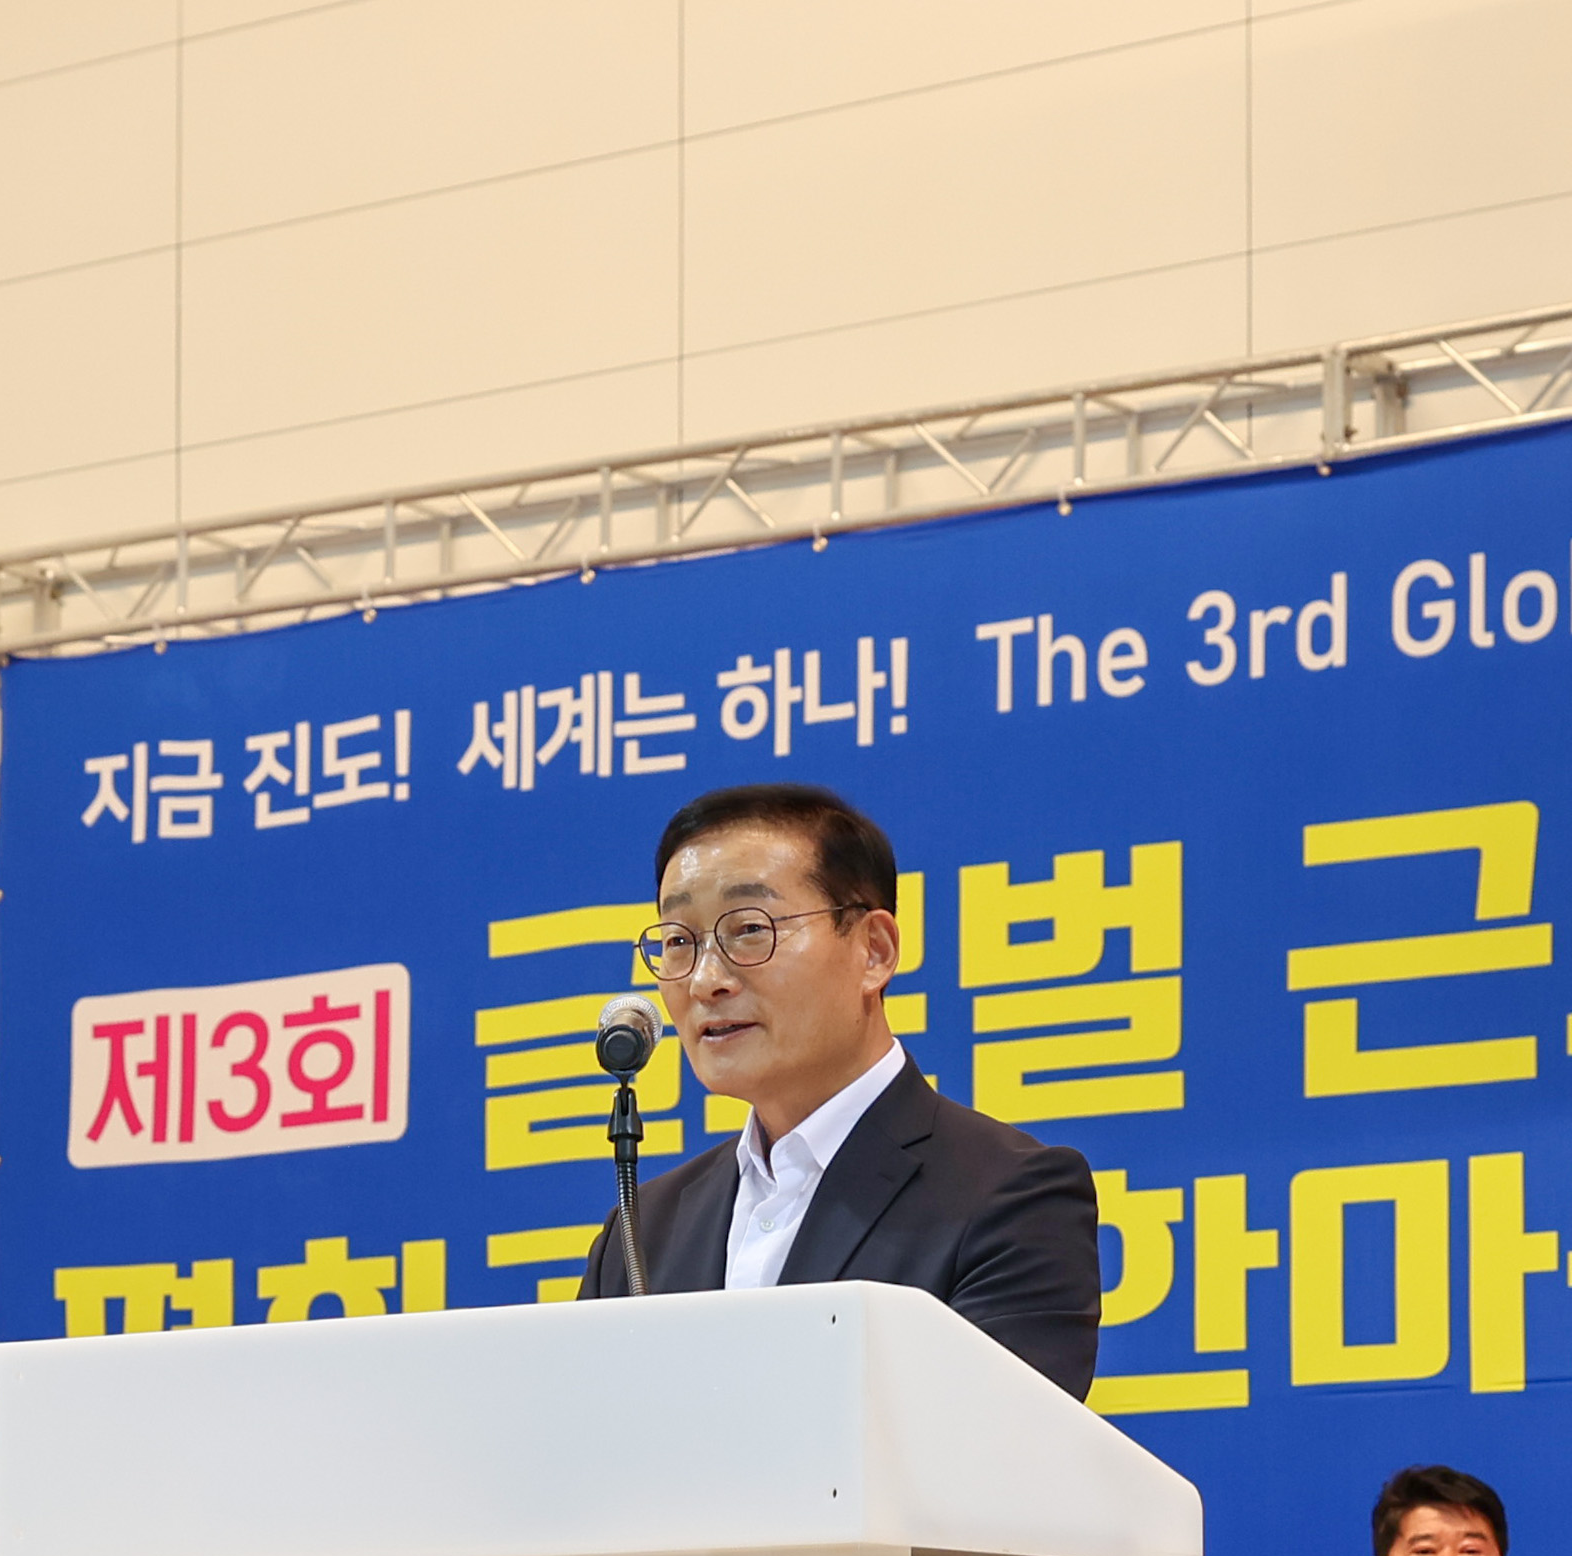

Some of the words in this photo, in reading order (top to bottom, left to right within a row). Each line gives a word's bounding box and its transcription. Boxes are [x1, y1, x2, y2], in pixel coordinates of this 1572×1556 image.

[81, 742, 223, 843] 지금
[243, 709, 411, 829] 진도!
[457, 671, 696, 791] 세계는
[717, 636, 909, 757] 하나!
[975, 613, 1148, 714] The
[1185, 571, 1348, 687] 3rd
[85, 989, 391, 1144] 제3회
[475, 840, 1184, 1171] 글벌
